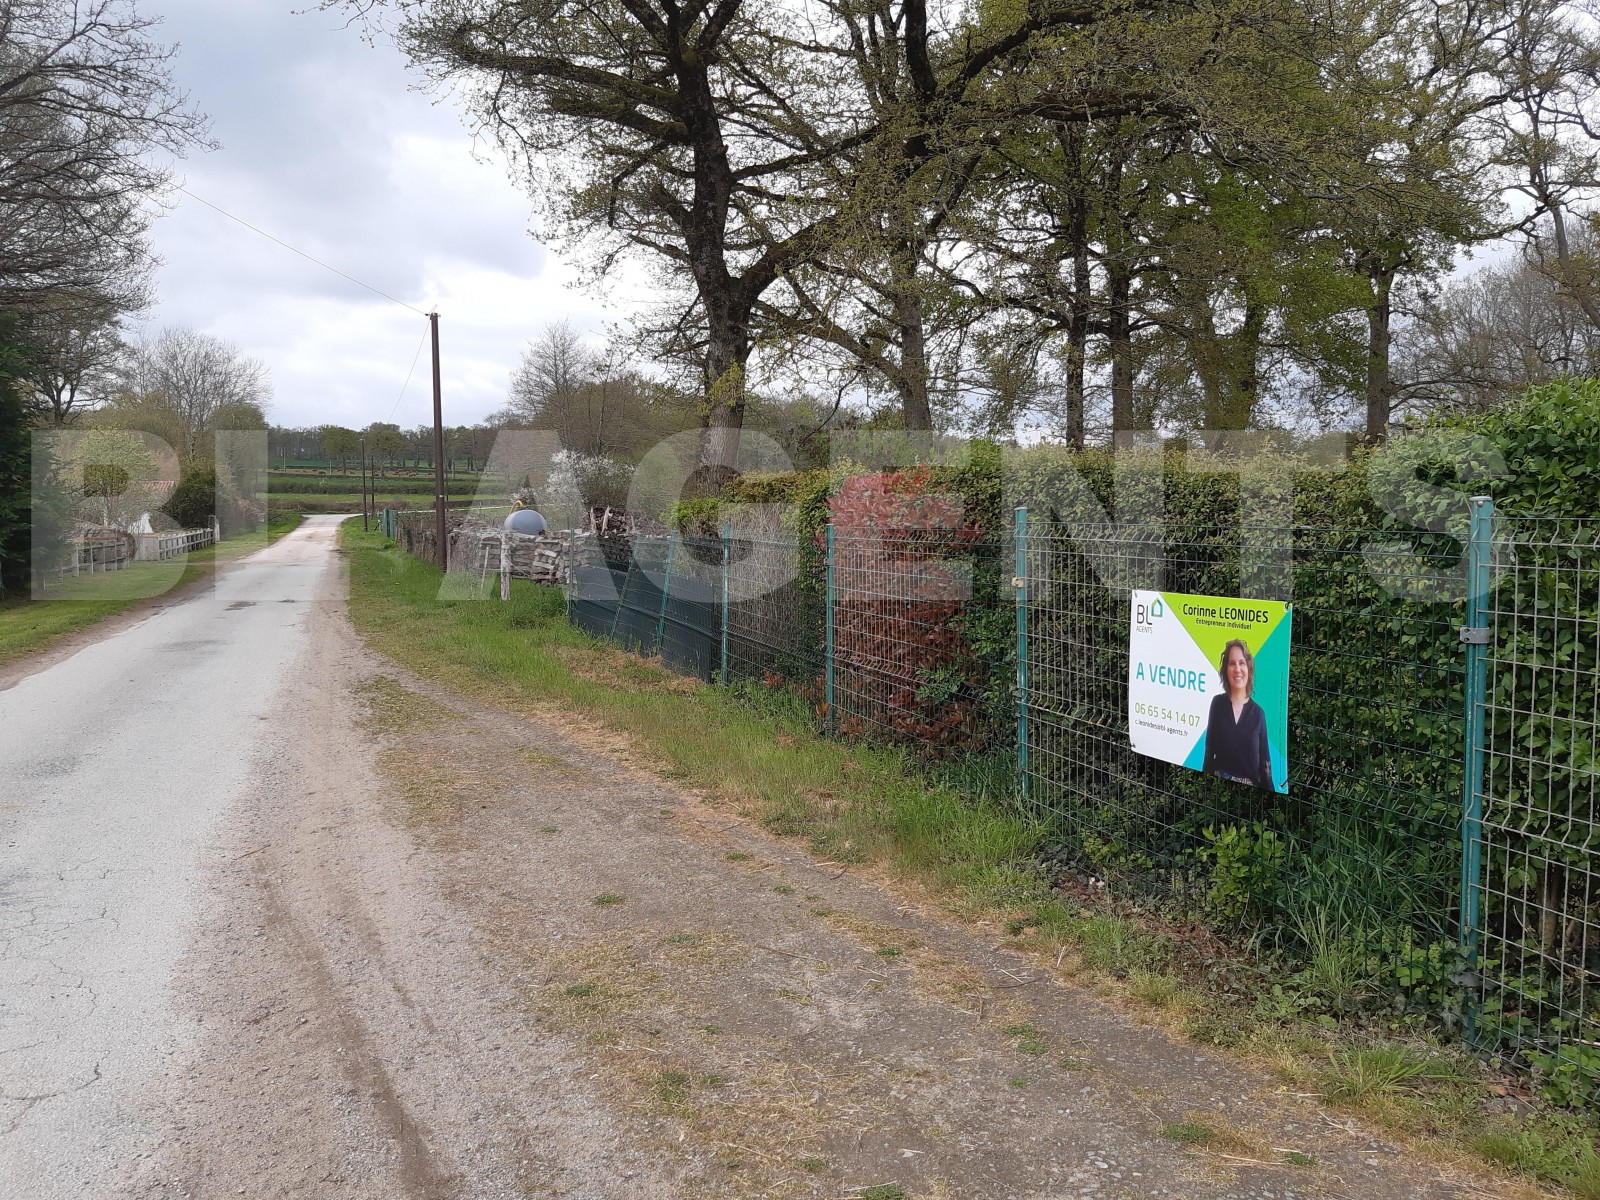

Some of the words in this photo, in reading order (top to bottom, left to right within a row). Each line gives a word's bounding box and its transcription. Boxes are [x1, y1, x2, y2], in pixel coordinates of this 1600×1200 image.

[1136, 604, 1153, 625] BL
[1183, 603, 1217, 618] Corinne
[1219, 606, 1269, 623] LEONIDES
[1195, 617, 1226, 627] Entrepreneur
[1136, 626, 1153, 634] AGENTS
[1136, 662, 1145, 681] A
[1149, 663, 1206, 692] VENDRE
[1135, 702, 1146, 715] 06
[1148, 705, 1159, 718] 65
[1161, 707, 1173, 721] 54
[1175, 711, 1186, 725] 14
[1188, 714, 1201, 728] 07
